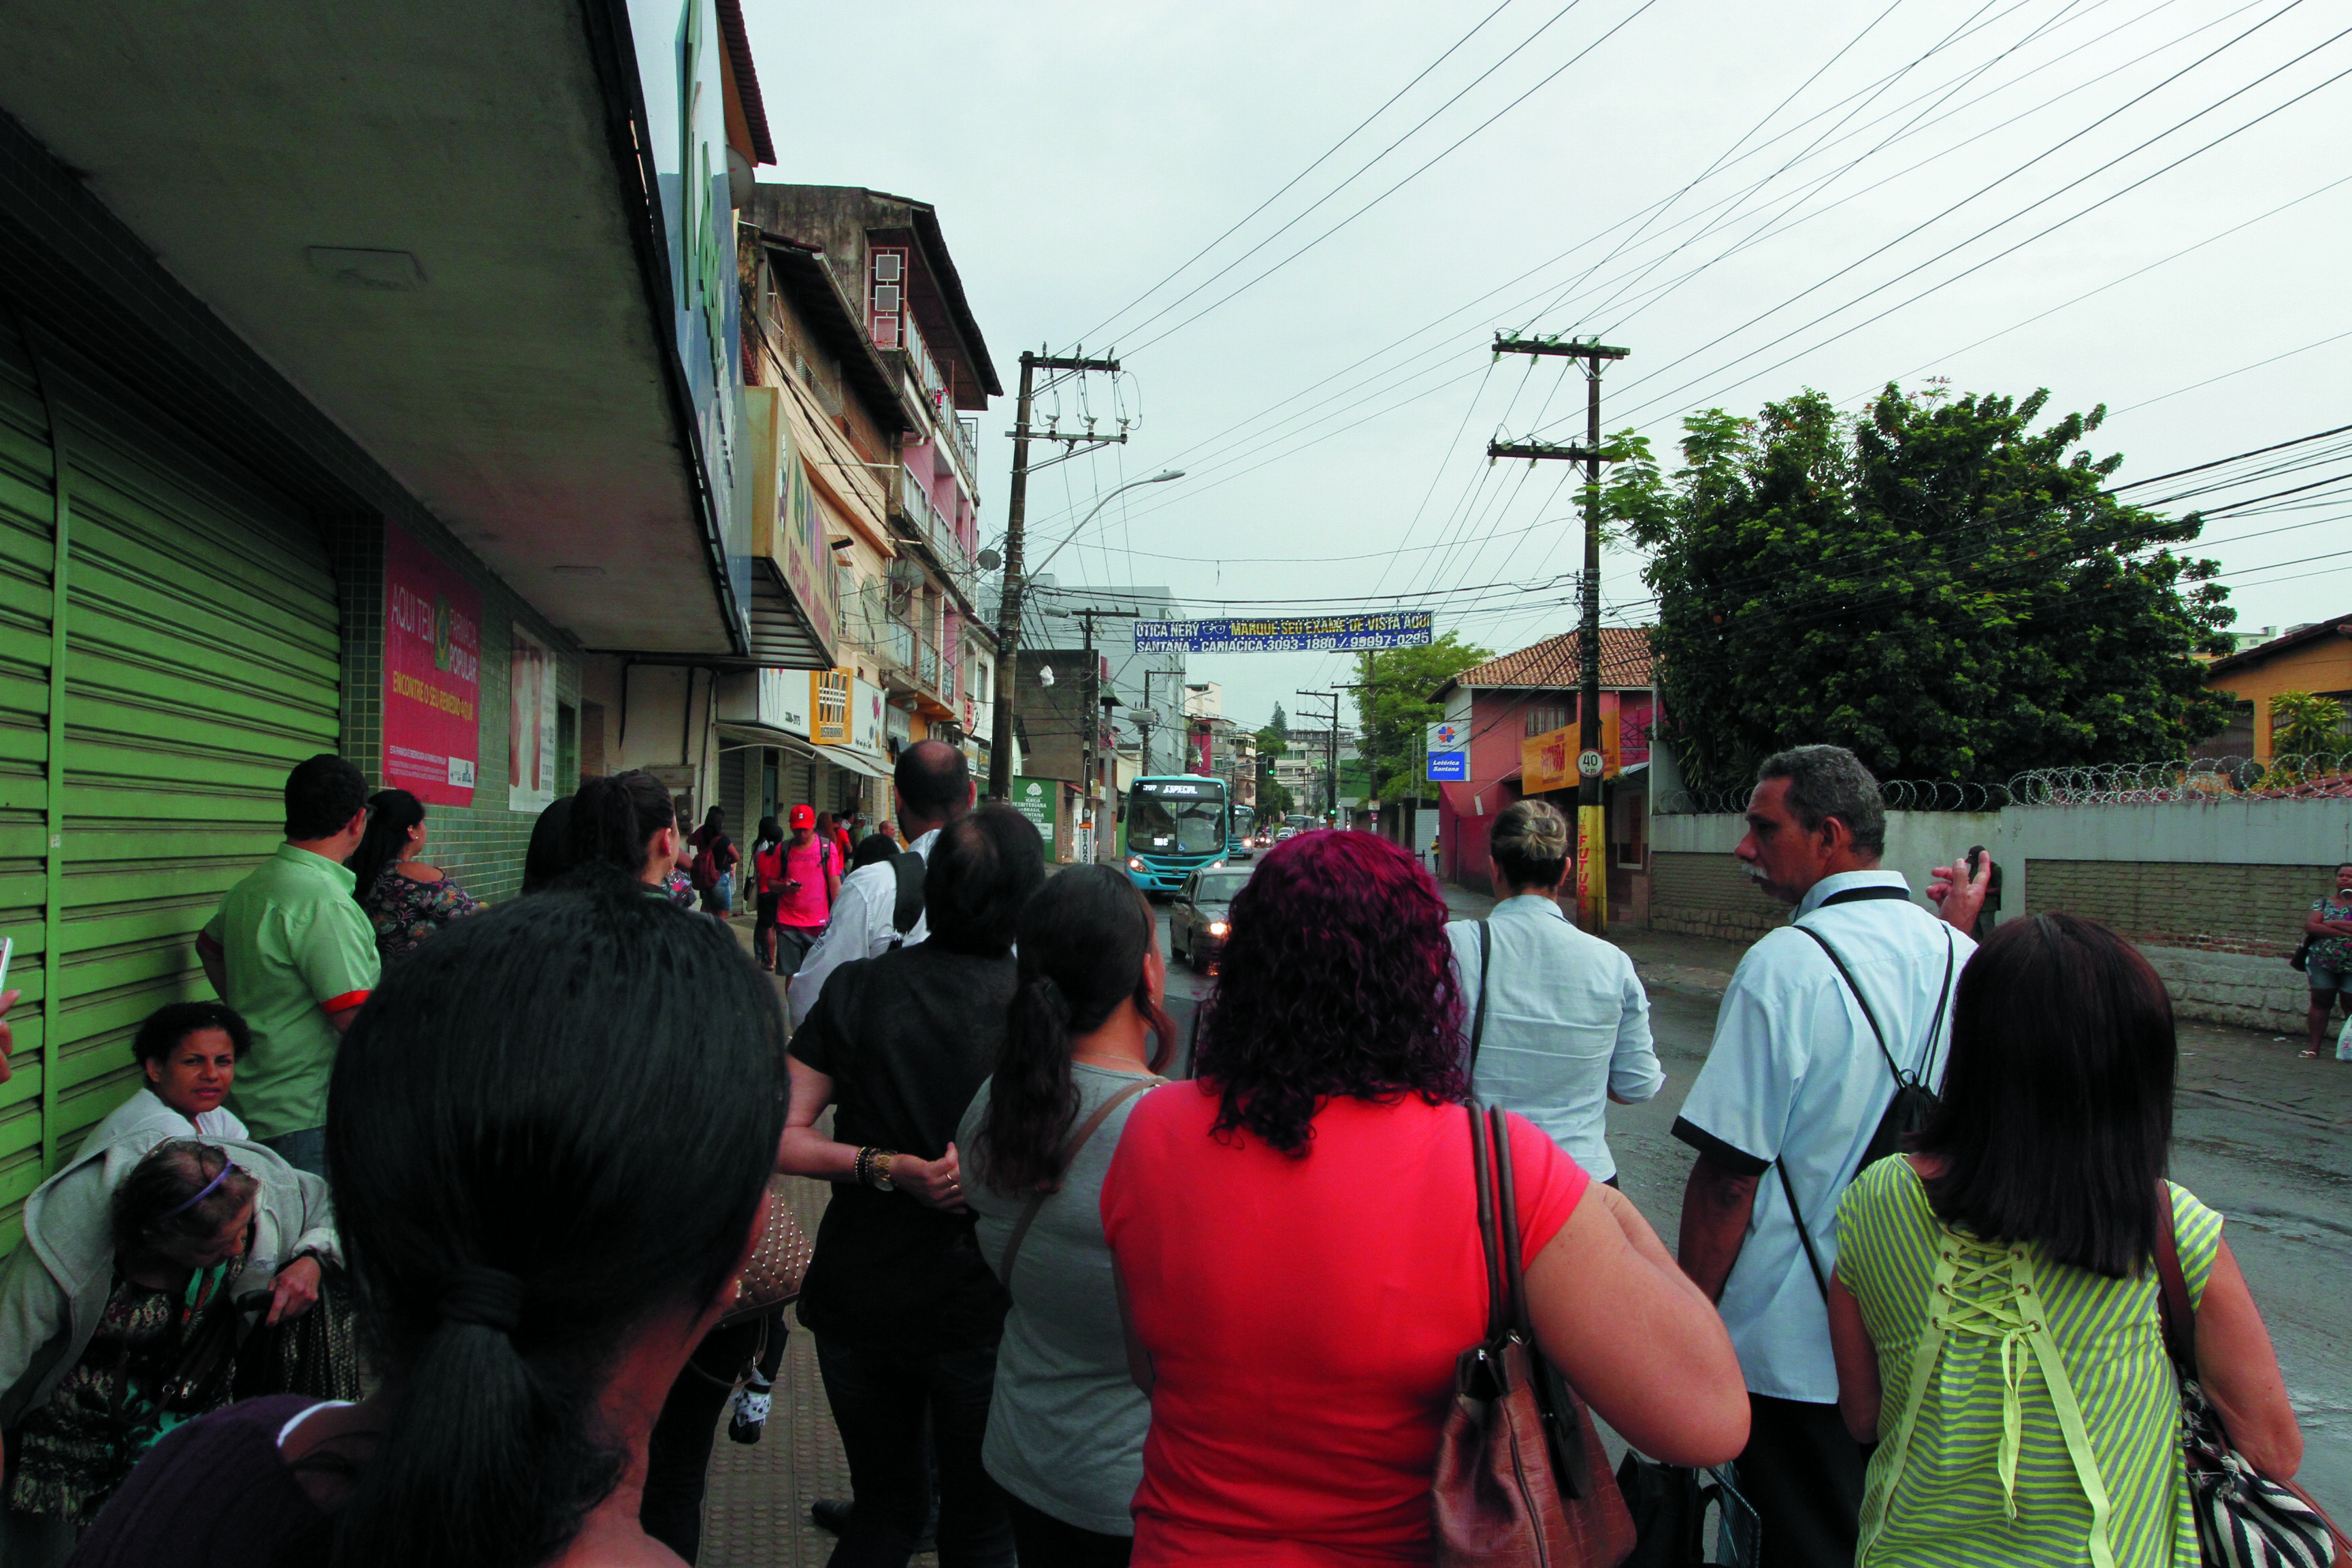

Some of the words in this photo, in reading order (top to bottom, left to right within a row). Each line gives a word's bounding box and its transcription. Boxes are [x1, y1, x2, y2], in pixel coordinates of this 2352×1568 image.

[391, 583, 415, 634] AQUI
[418, 598, 435, 644] TEM
[1171, 623, 1200, 637] NERY
[1230, 623, 1278, 636] MARQUE
[1281, 620, 1303, 634] SEU
[1305, 619, 1346, 634] EXAME
[1349, 617, 1365, 632] DE
[1367, 615, 1400, 631] VISTA
[1403, 613, 1430, 630] AQUI
[1137, 640, 1190, 653] SANTANA
[449, 643, 477, 683] POPULAR
[393, 670, 424, 702] ENCONTRE
[425, 683, 429, 704] O
[429, 685, 440, 708] SEU
[1583, 755, 1598, 766] 40
[1162, 785, 1198, 794] ESPECIAL
